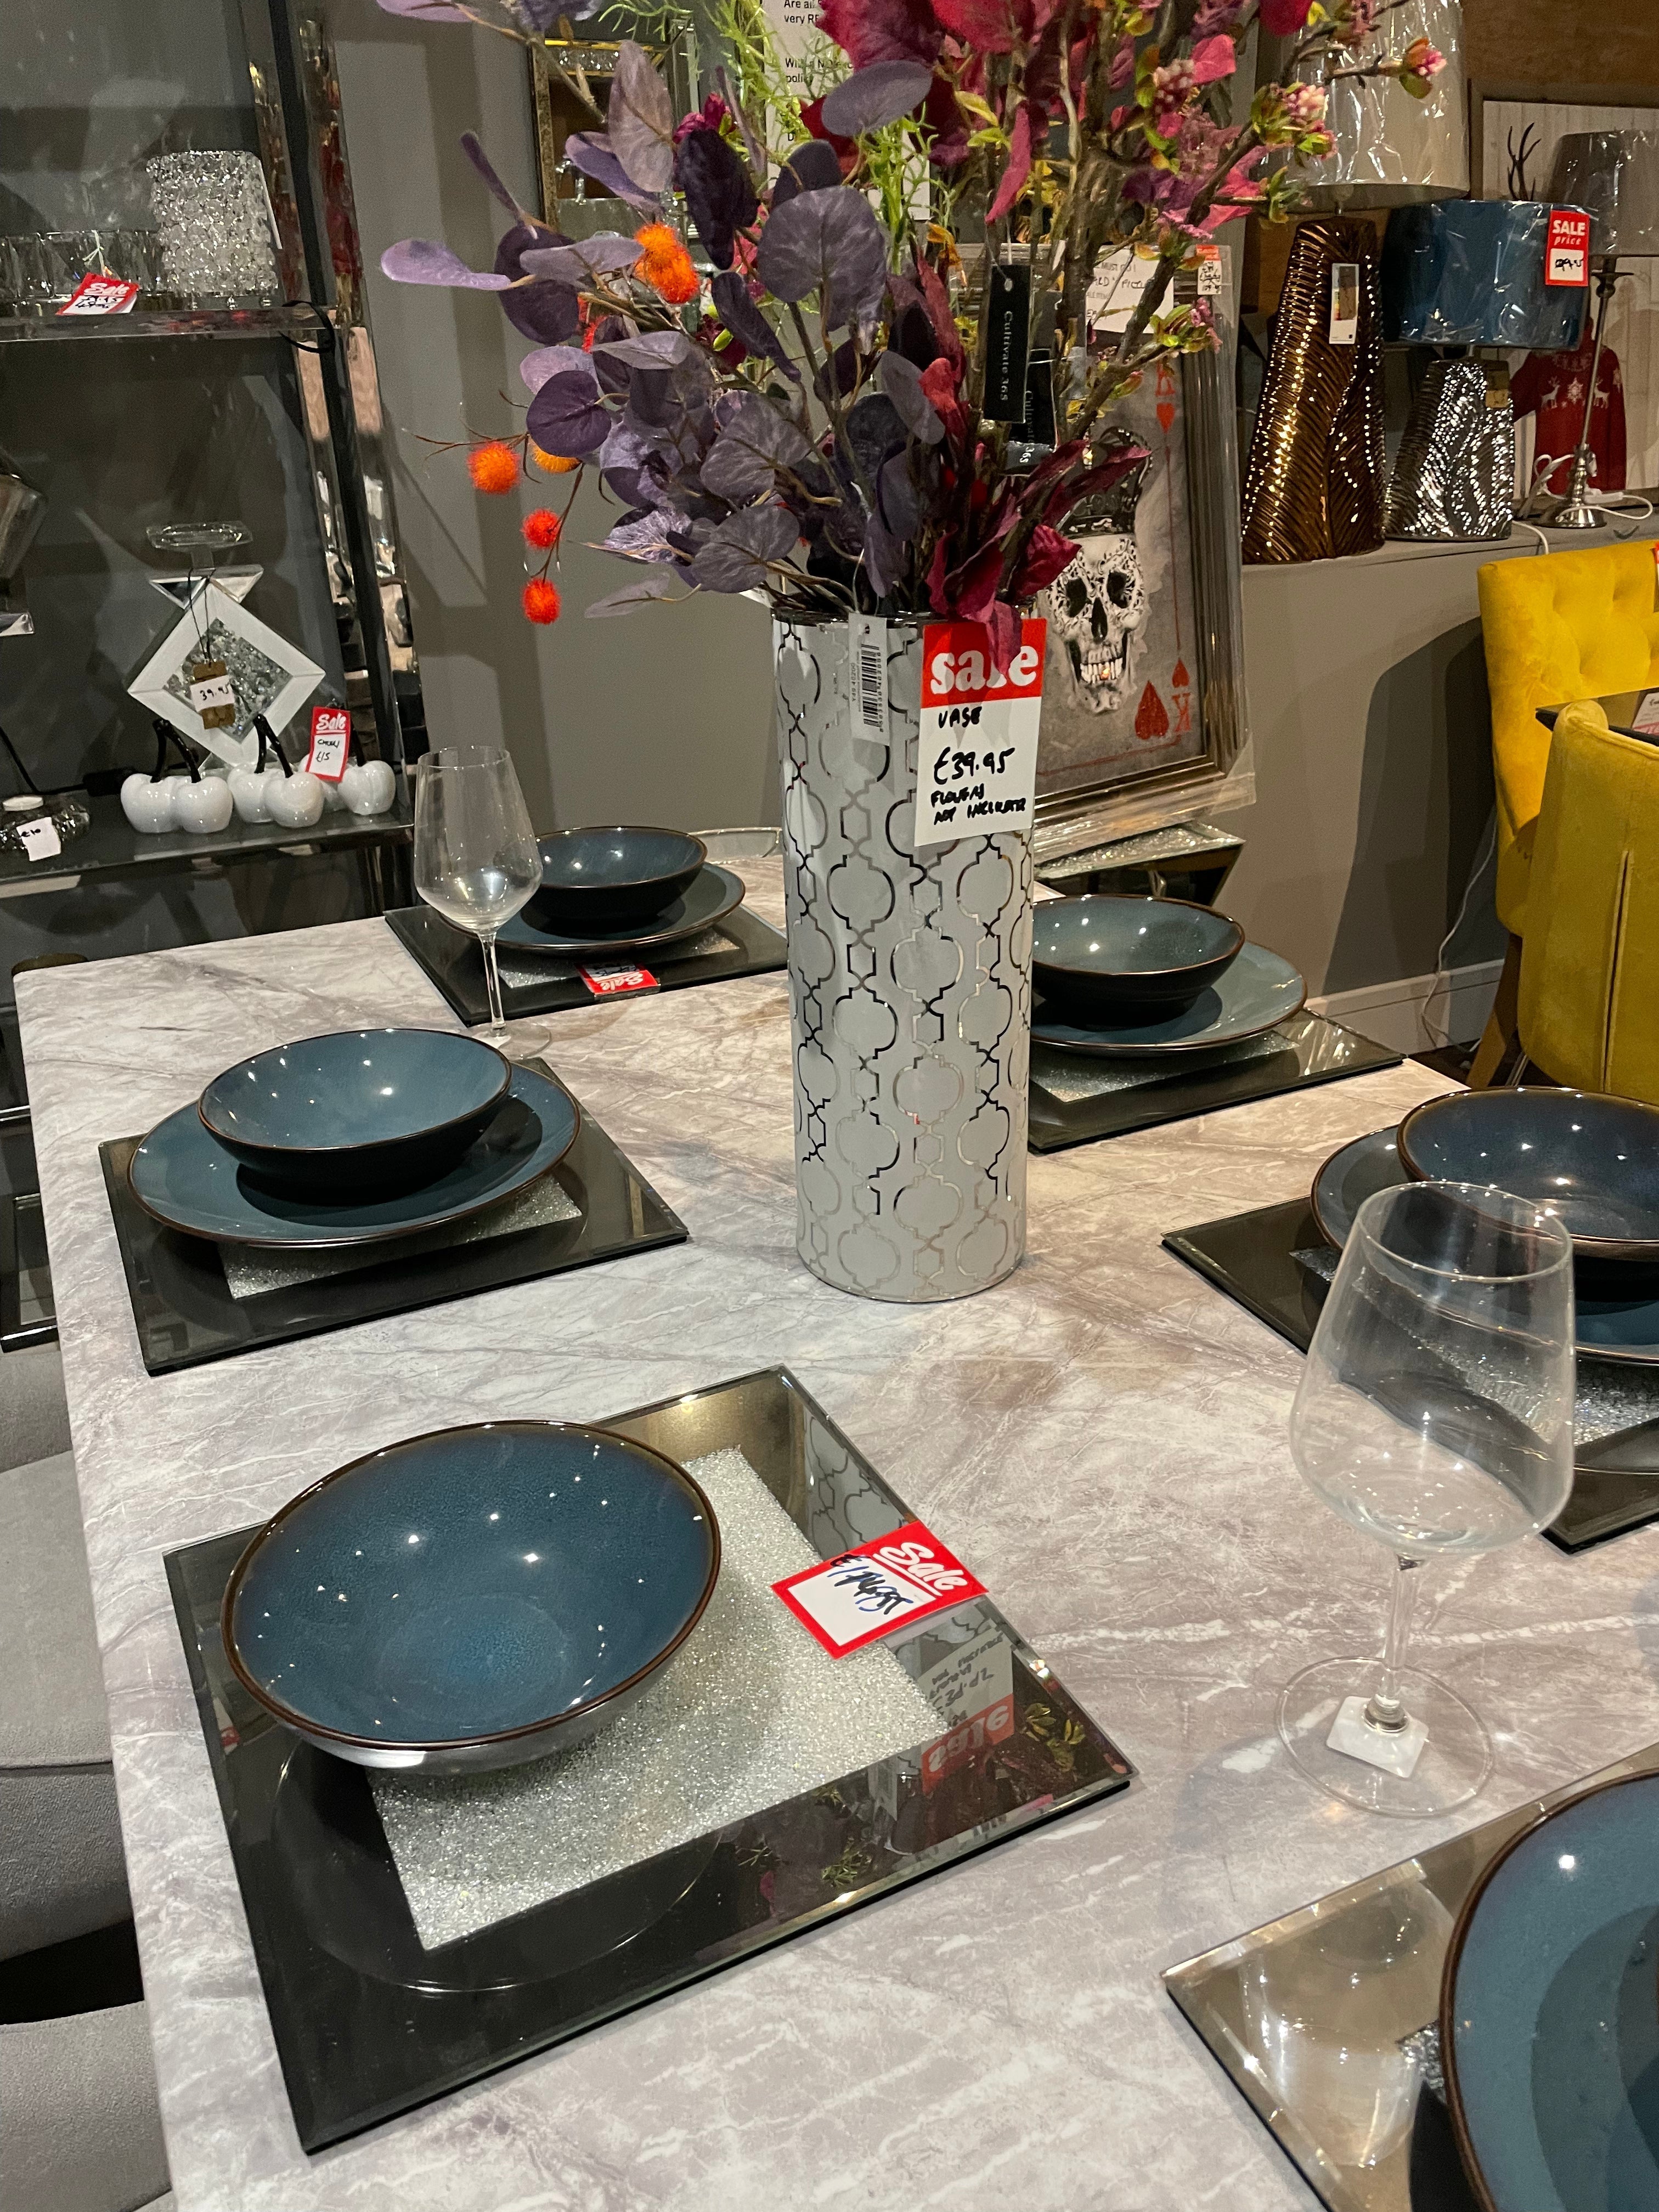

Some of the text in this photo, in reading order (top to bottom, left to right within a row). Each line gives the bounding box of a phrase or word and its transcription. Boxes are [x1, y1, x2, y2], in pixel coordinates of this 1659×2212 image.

[784, 15, 805, 25] very
[1552, 219, 1585, 236] SALE
[1553, 236, 1581, 246] price
[1002, 311, 1013, 374] Cultivate
[315, 712, 347, 730] Sale
[938, 706, 982, 729] VASE
[934, 746, 1015, 785] £39.95
[879, 1542, 968, 1591] Sale
